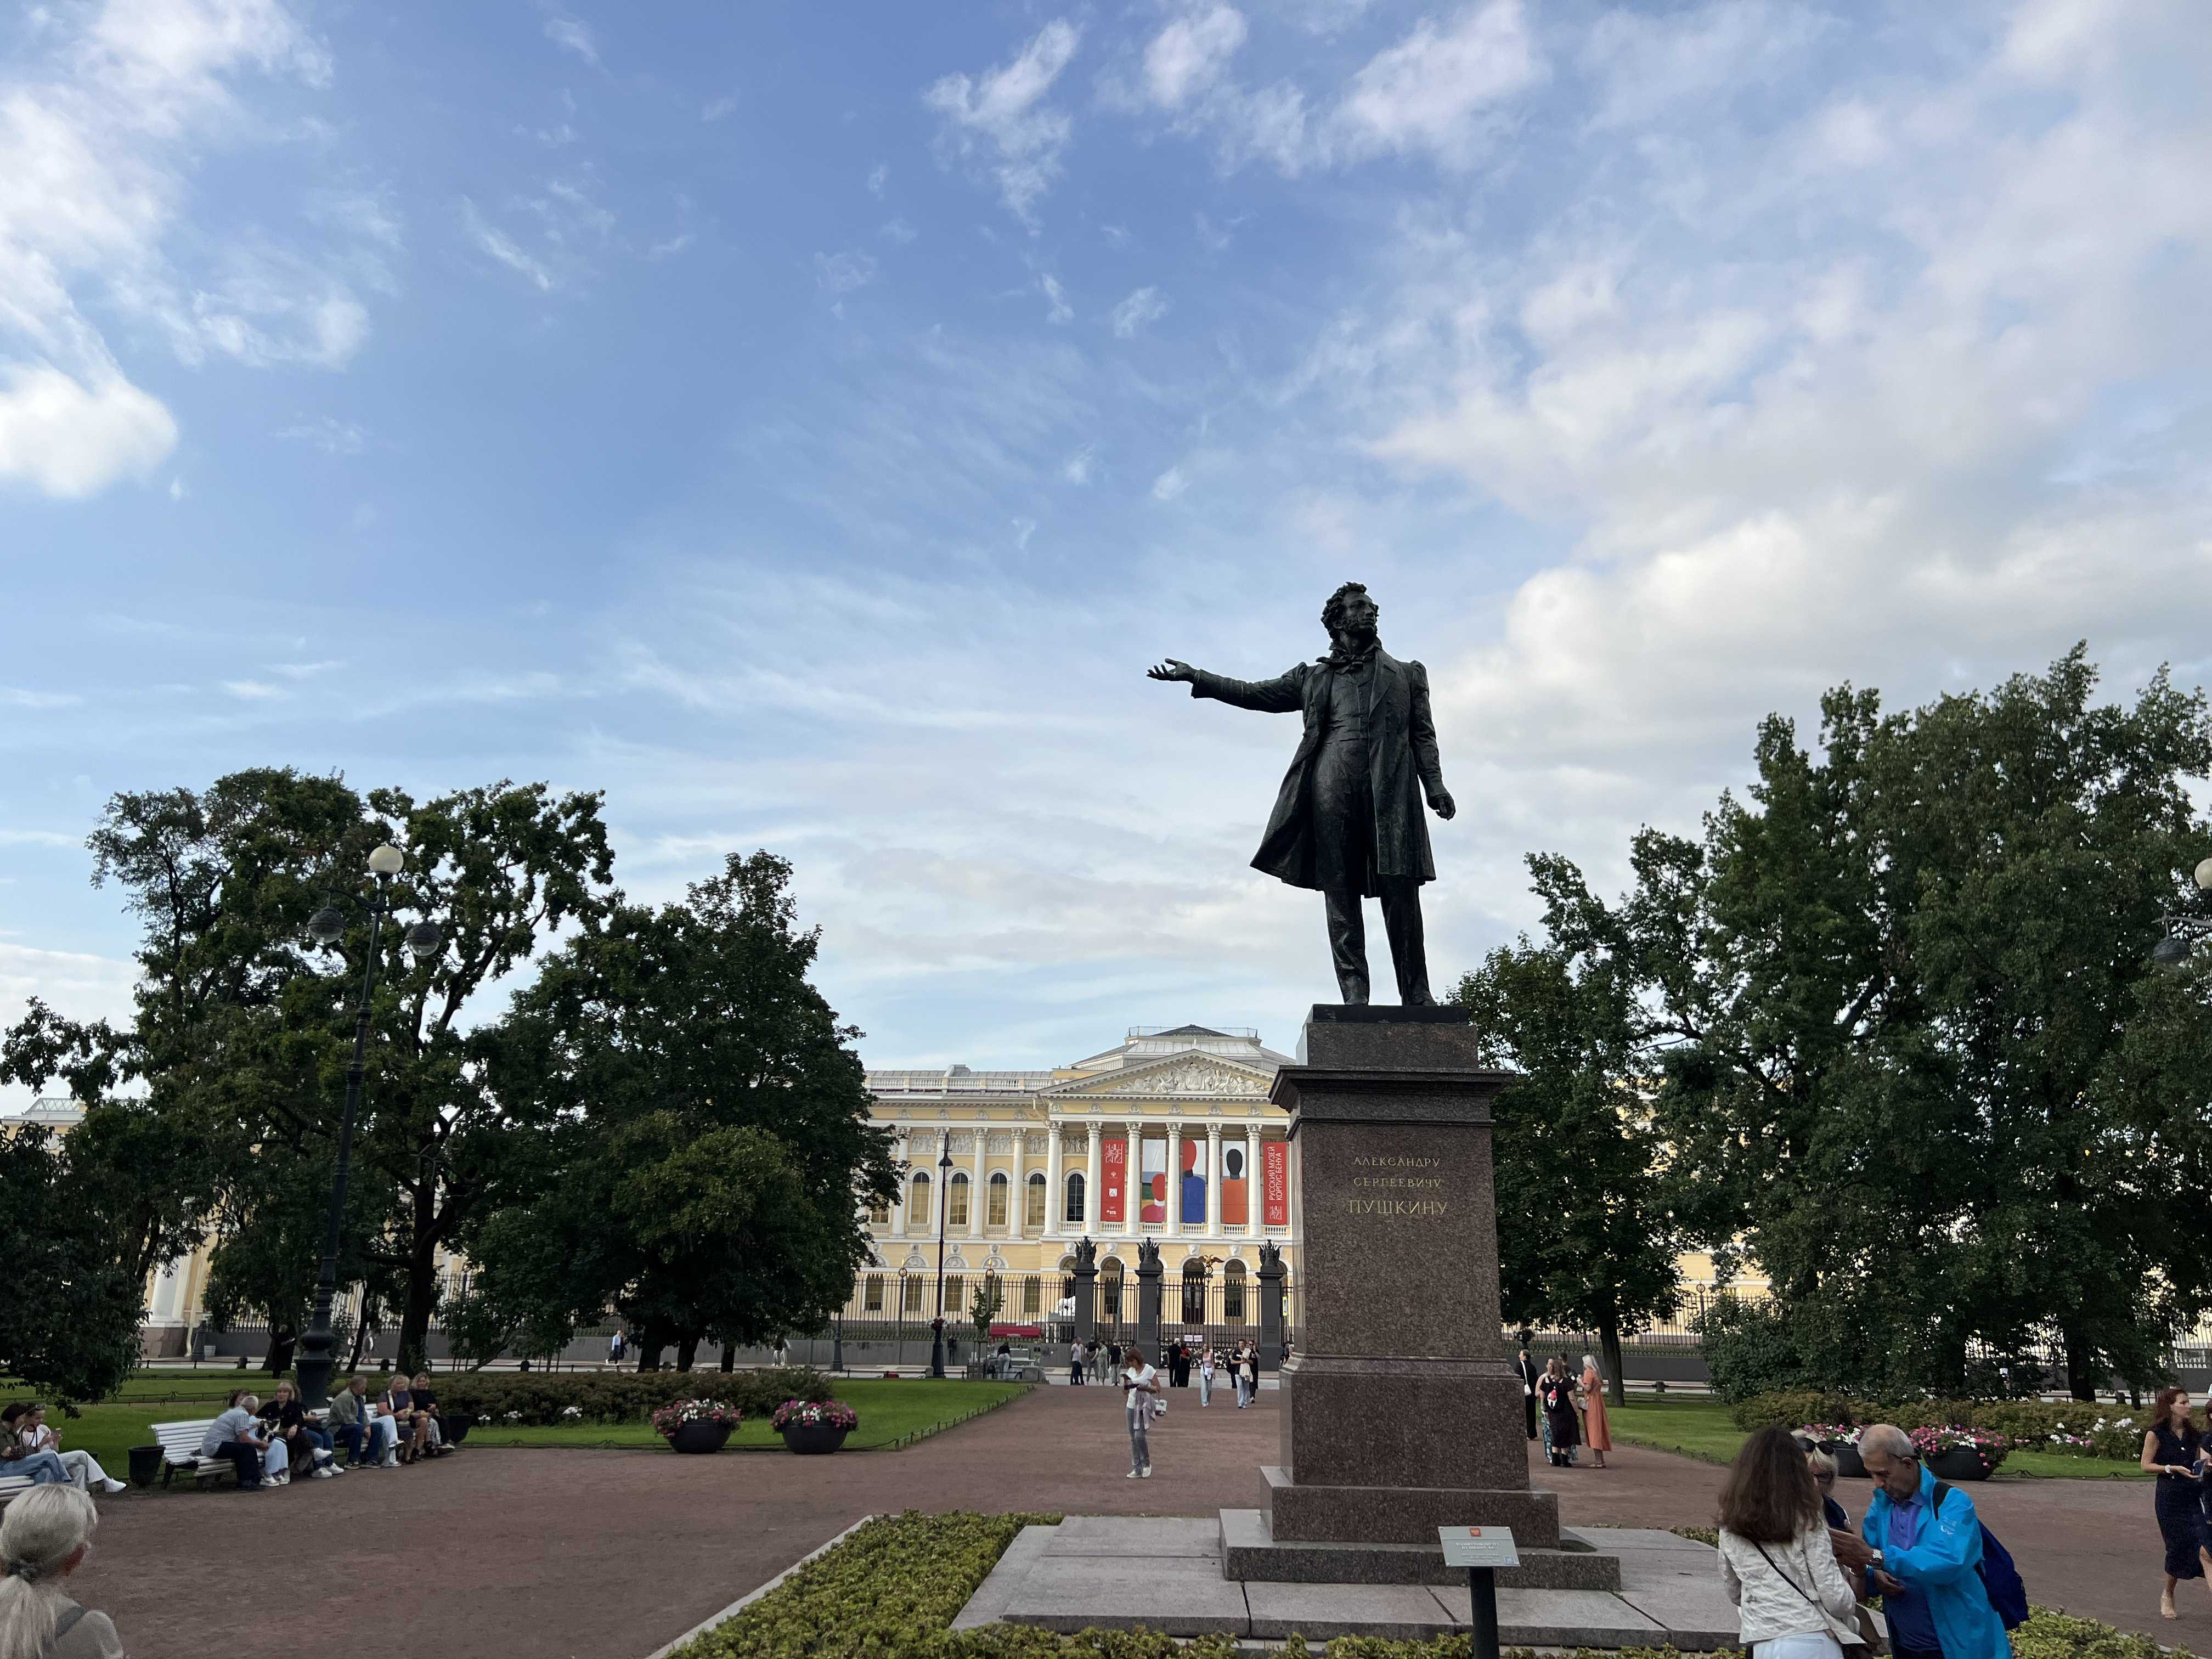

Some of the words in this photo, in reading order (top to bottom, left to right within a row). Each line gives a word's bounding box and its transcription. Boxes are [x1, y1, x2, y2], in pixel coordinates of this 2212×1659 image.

[1267, 1146, 1276, 1169] МУЗЕЙ
[1353, 1156, 1440, 1167] АЛЕКСАНДРУ
[1353, 1177, 1440, 1188] СЕРГЕЕВИЧУ
[1350, 1199, 1448, 1215] ПУШКИНУ
